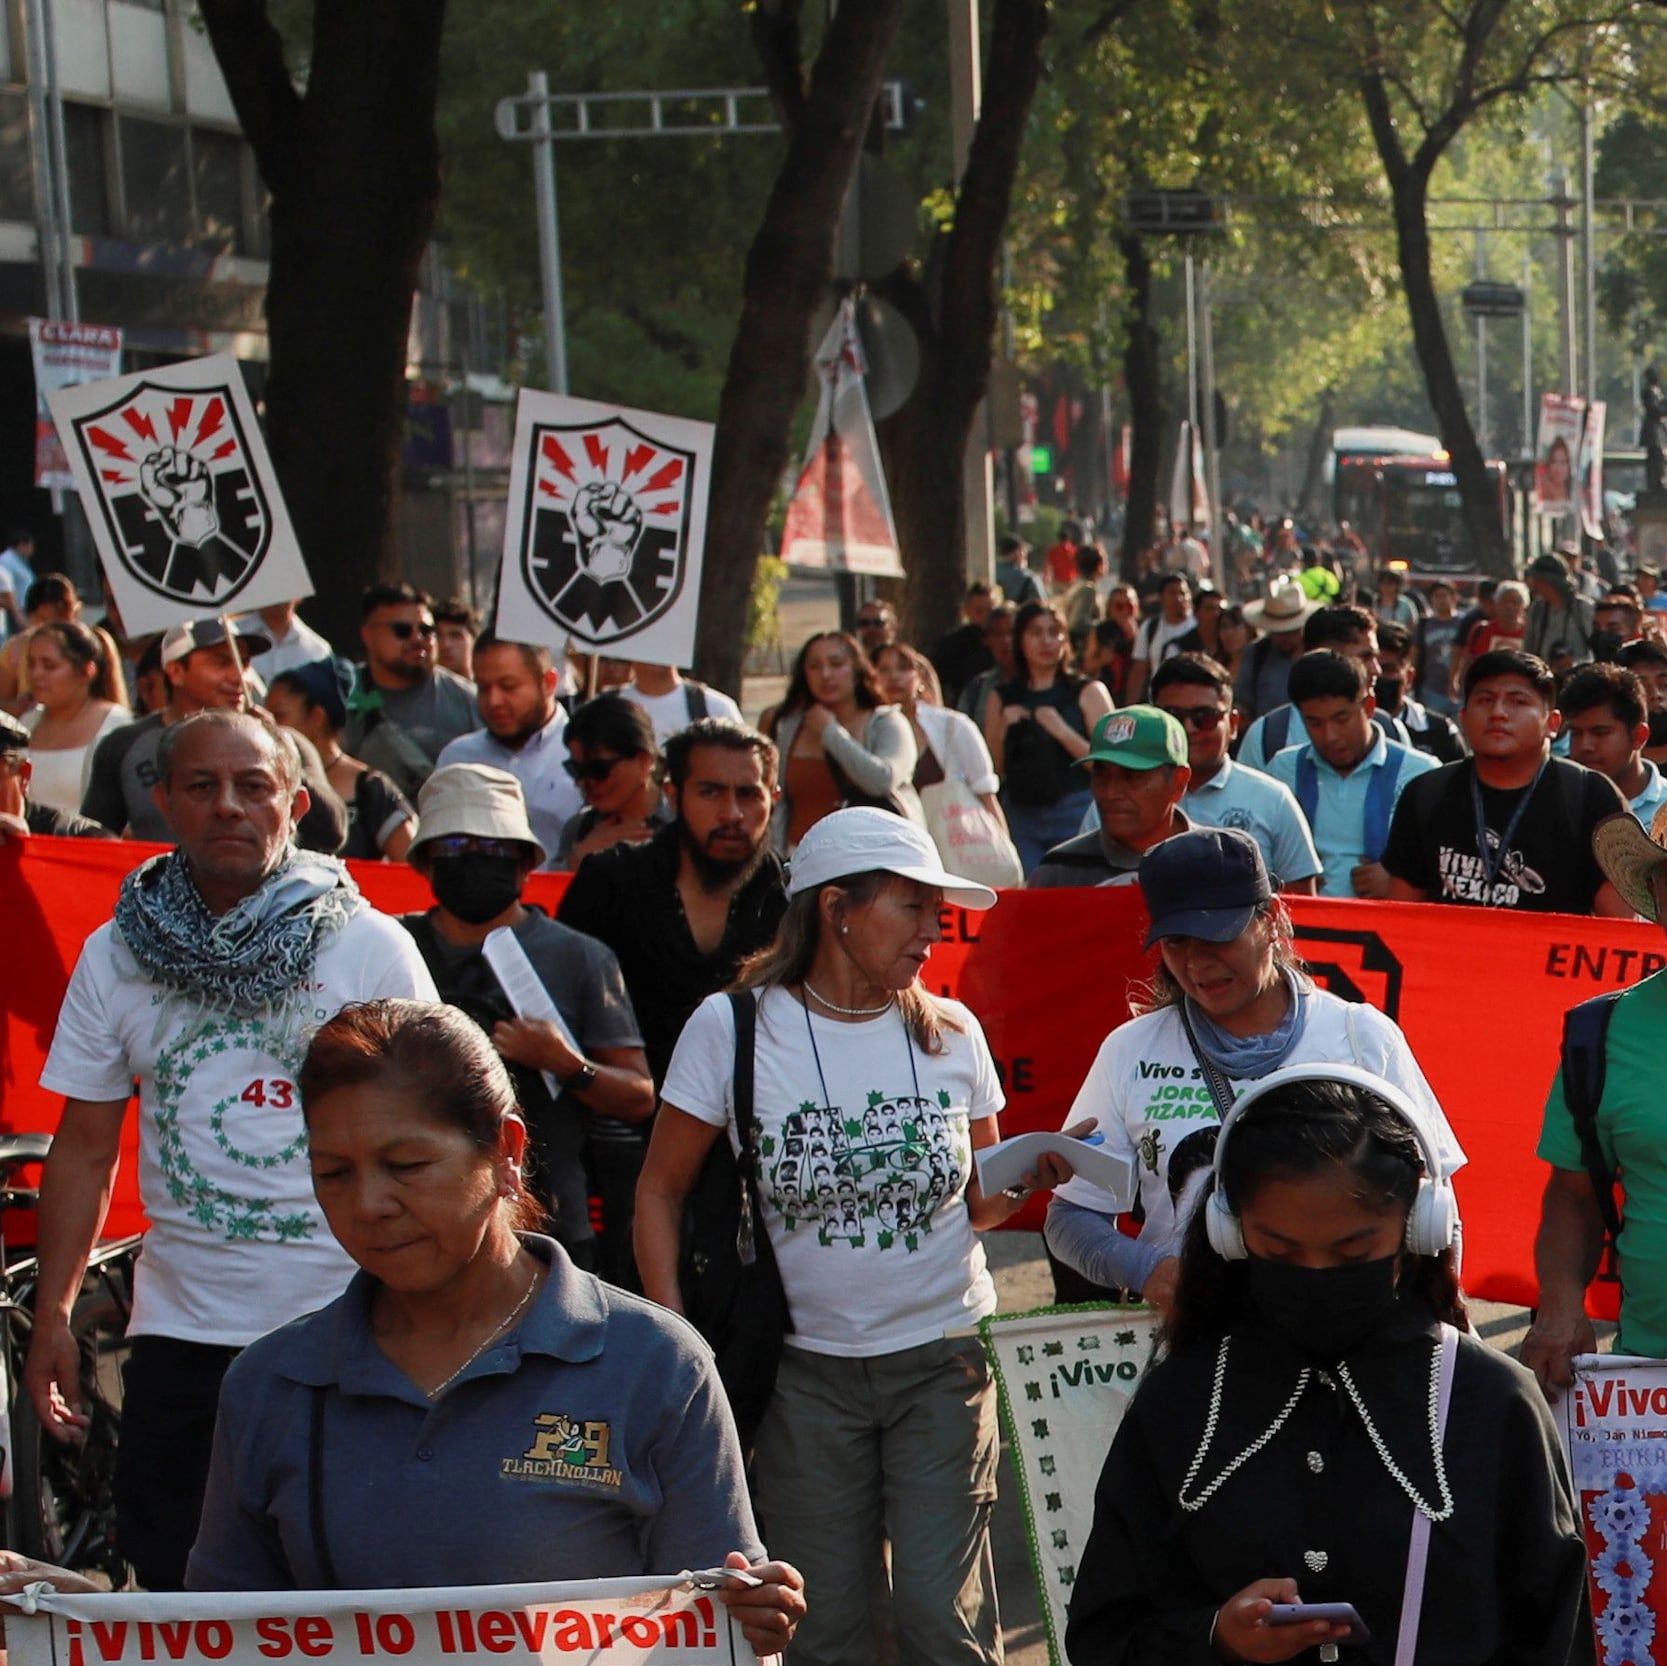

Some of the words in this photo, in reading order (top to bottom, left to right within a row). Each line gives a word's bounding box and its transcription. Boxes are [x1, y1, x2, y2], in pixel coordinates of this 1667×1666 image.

[240, 1079, 293, 1109] 43
[1049, 1358, 1138, 1399] ¡Vivo
[502, 1457, 623, 1487] TLACHINOLLAN
[256, 1613, 334, 1660] se
[355, 1610, 417, 1656] lo
[437, 1595, 718, 1655] llevaron!
